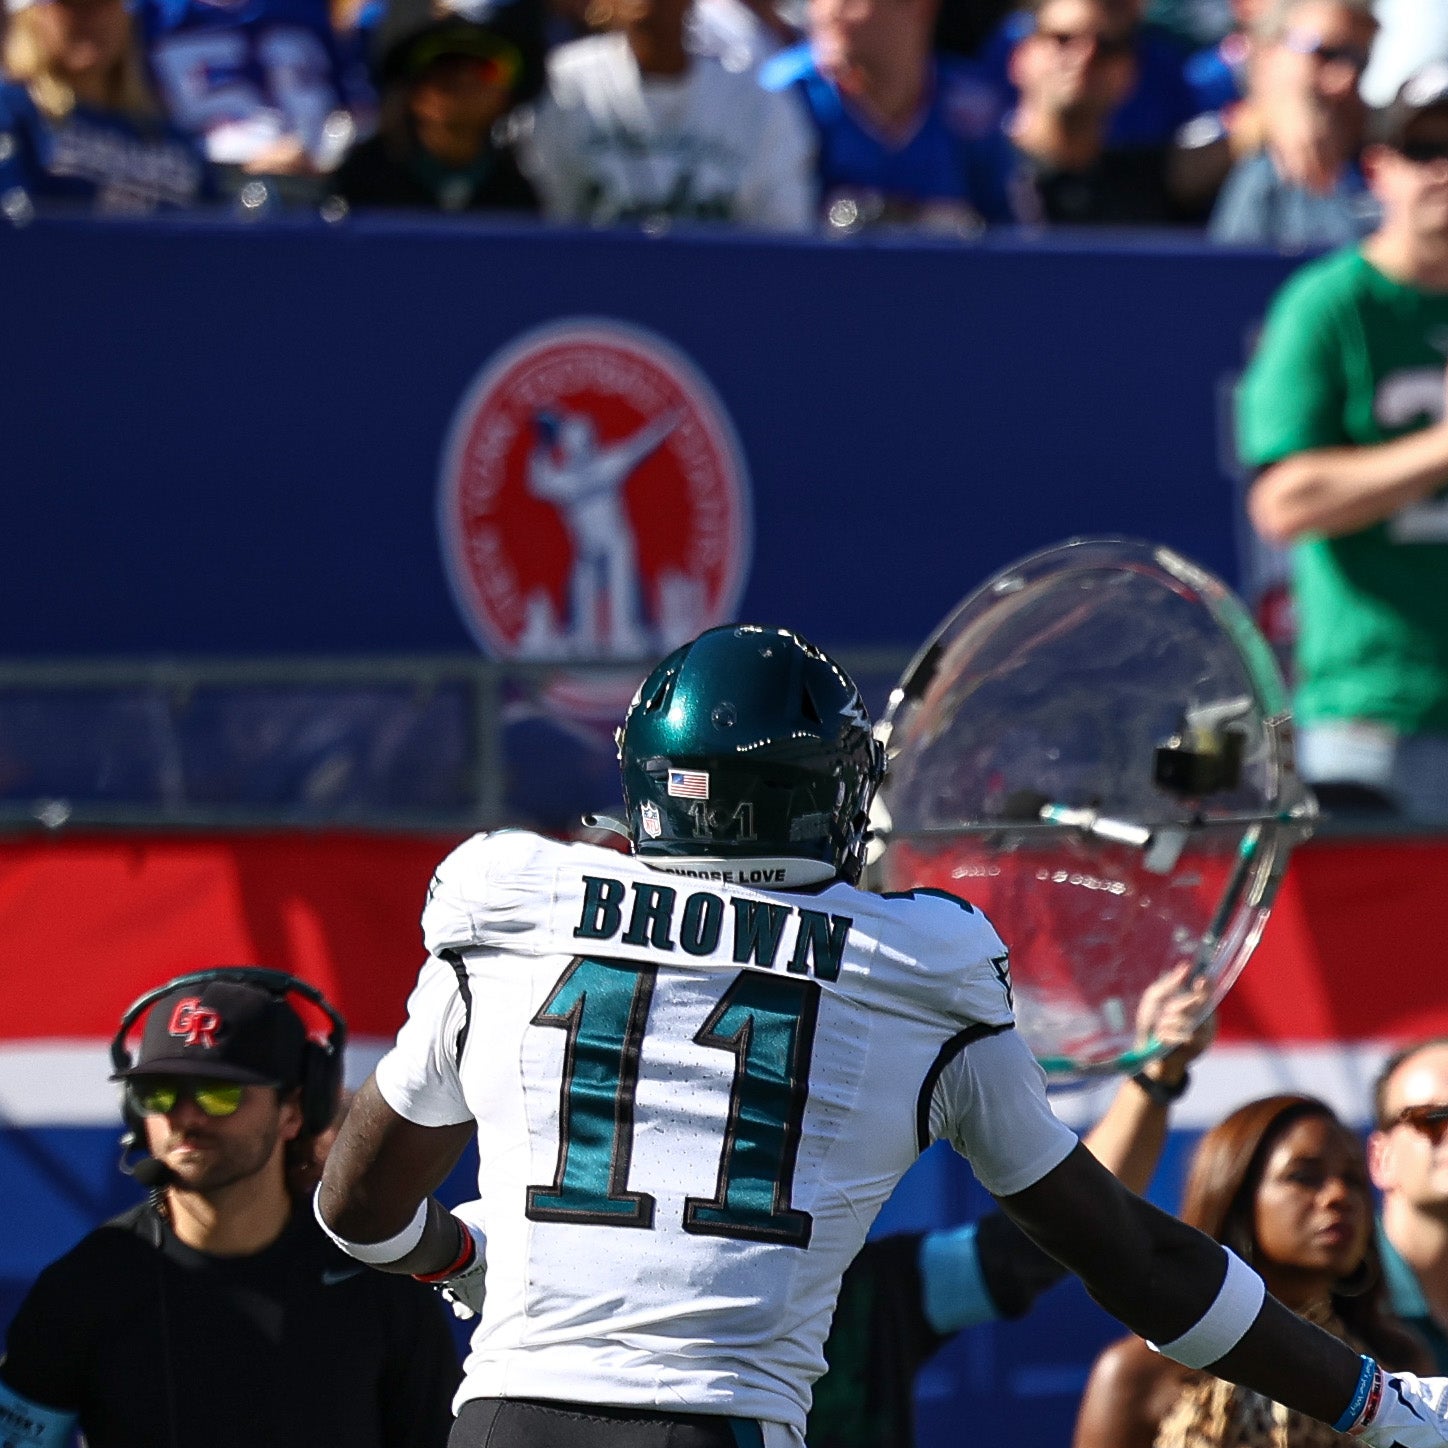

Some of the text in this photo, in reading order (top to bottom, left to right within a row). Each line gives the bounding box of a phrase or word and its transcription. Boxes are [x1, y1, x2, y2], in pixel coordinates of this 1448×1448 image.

[739, 868, 787, 884] LOVE
[573, 874, 854, 982] BROWN
[168, 996, 222, 1050] GR
[526, 954, 822, 1250] 11
